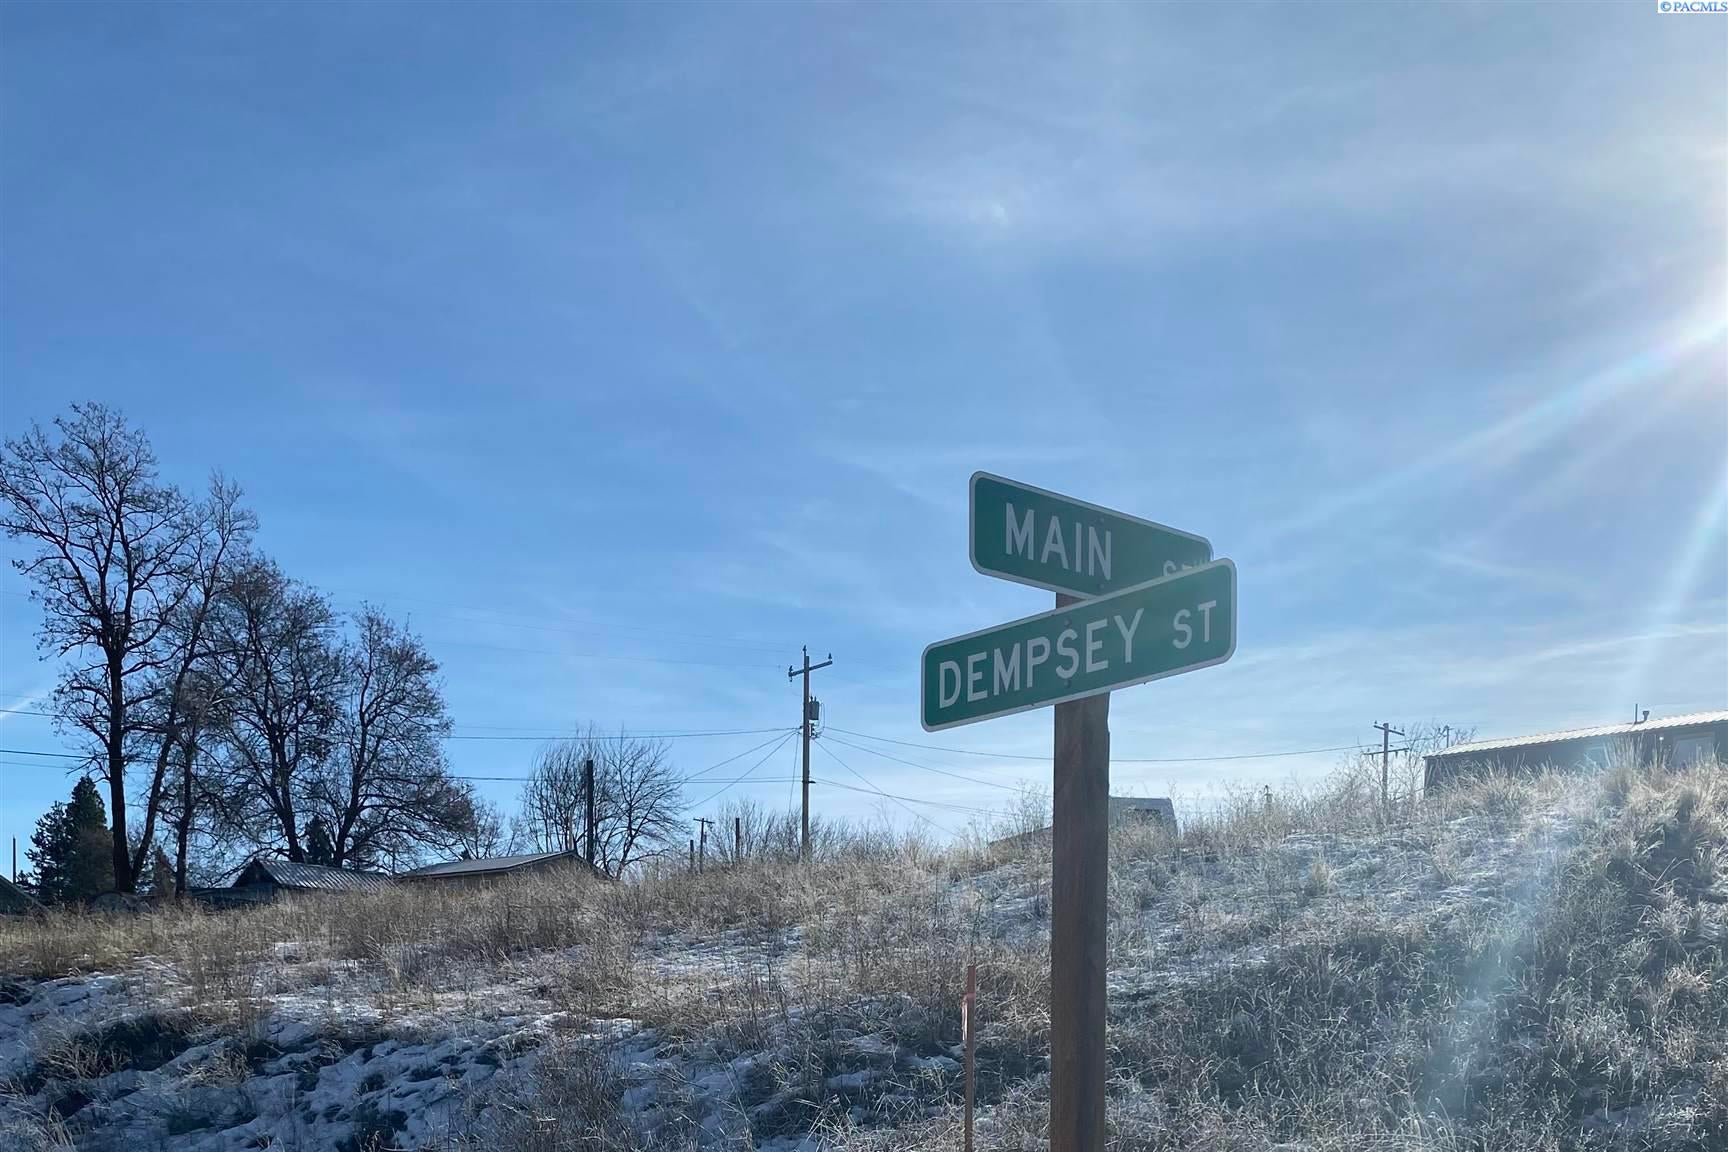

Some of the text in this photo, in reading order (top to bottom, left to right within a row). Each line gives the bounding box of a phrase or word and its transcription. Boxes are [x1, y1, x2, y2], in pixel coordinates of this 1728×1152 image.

[1005, 502, 1111, 580] MAIN
[939, 600, 1216, 708] DEMPSEY ST
